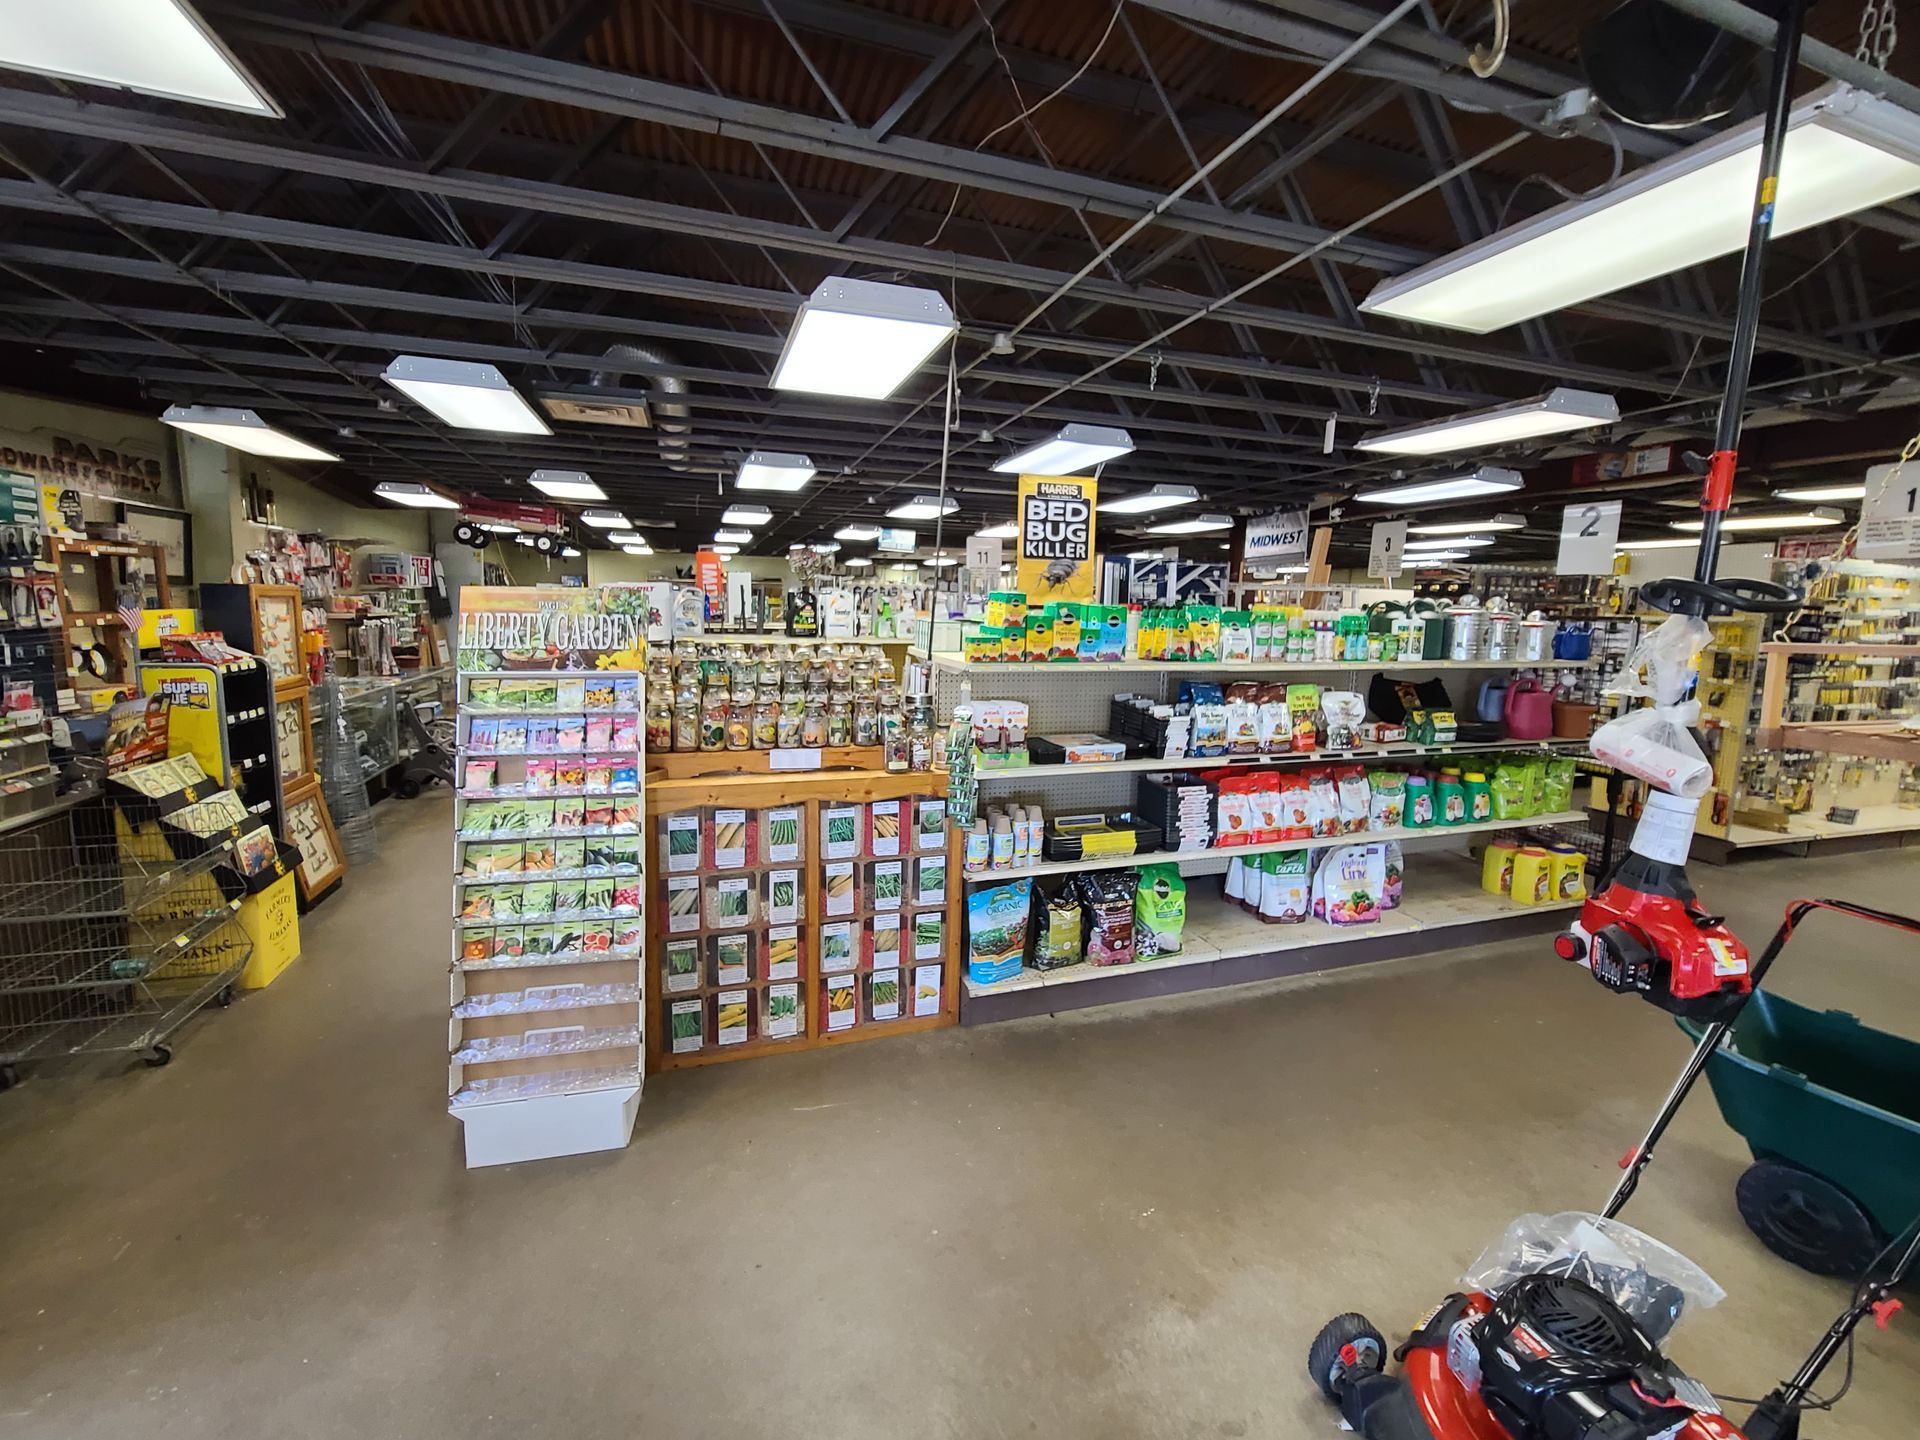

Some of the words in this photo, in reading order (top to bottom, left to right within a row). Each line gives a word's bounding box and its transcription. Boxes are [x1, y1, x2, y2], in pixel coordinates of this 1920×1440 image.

[52, 436, 161, 482] PARKS
[0, 447, 79, 477] DWARE
[94, 468, 161, 494] SUPPLY
[1040, 483, 1079, 495] HARRIS
[1907, 487, 1918, 513] 1
[1027, 500, 1089, 522] BED
[1580, 505, 1602, 537] 2
[1026, 521, 1087, 542] BUG
[1249, 529, 1304, 549] MIDWEST
[1026, 541, 1086, 558] KILLER
[1384, 537, 1392, 552] 3
[977, 551, 988, 564] 11
[460, 612, 548, 650] LIBERTY
[556, 612, 641, 650] GARDEN
[163, 682, 209, 694] SUPER
[171, 693, 189, 704] UE
[986, 899, 1025, 916] ORGANIC
